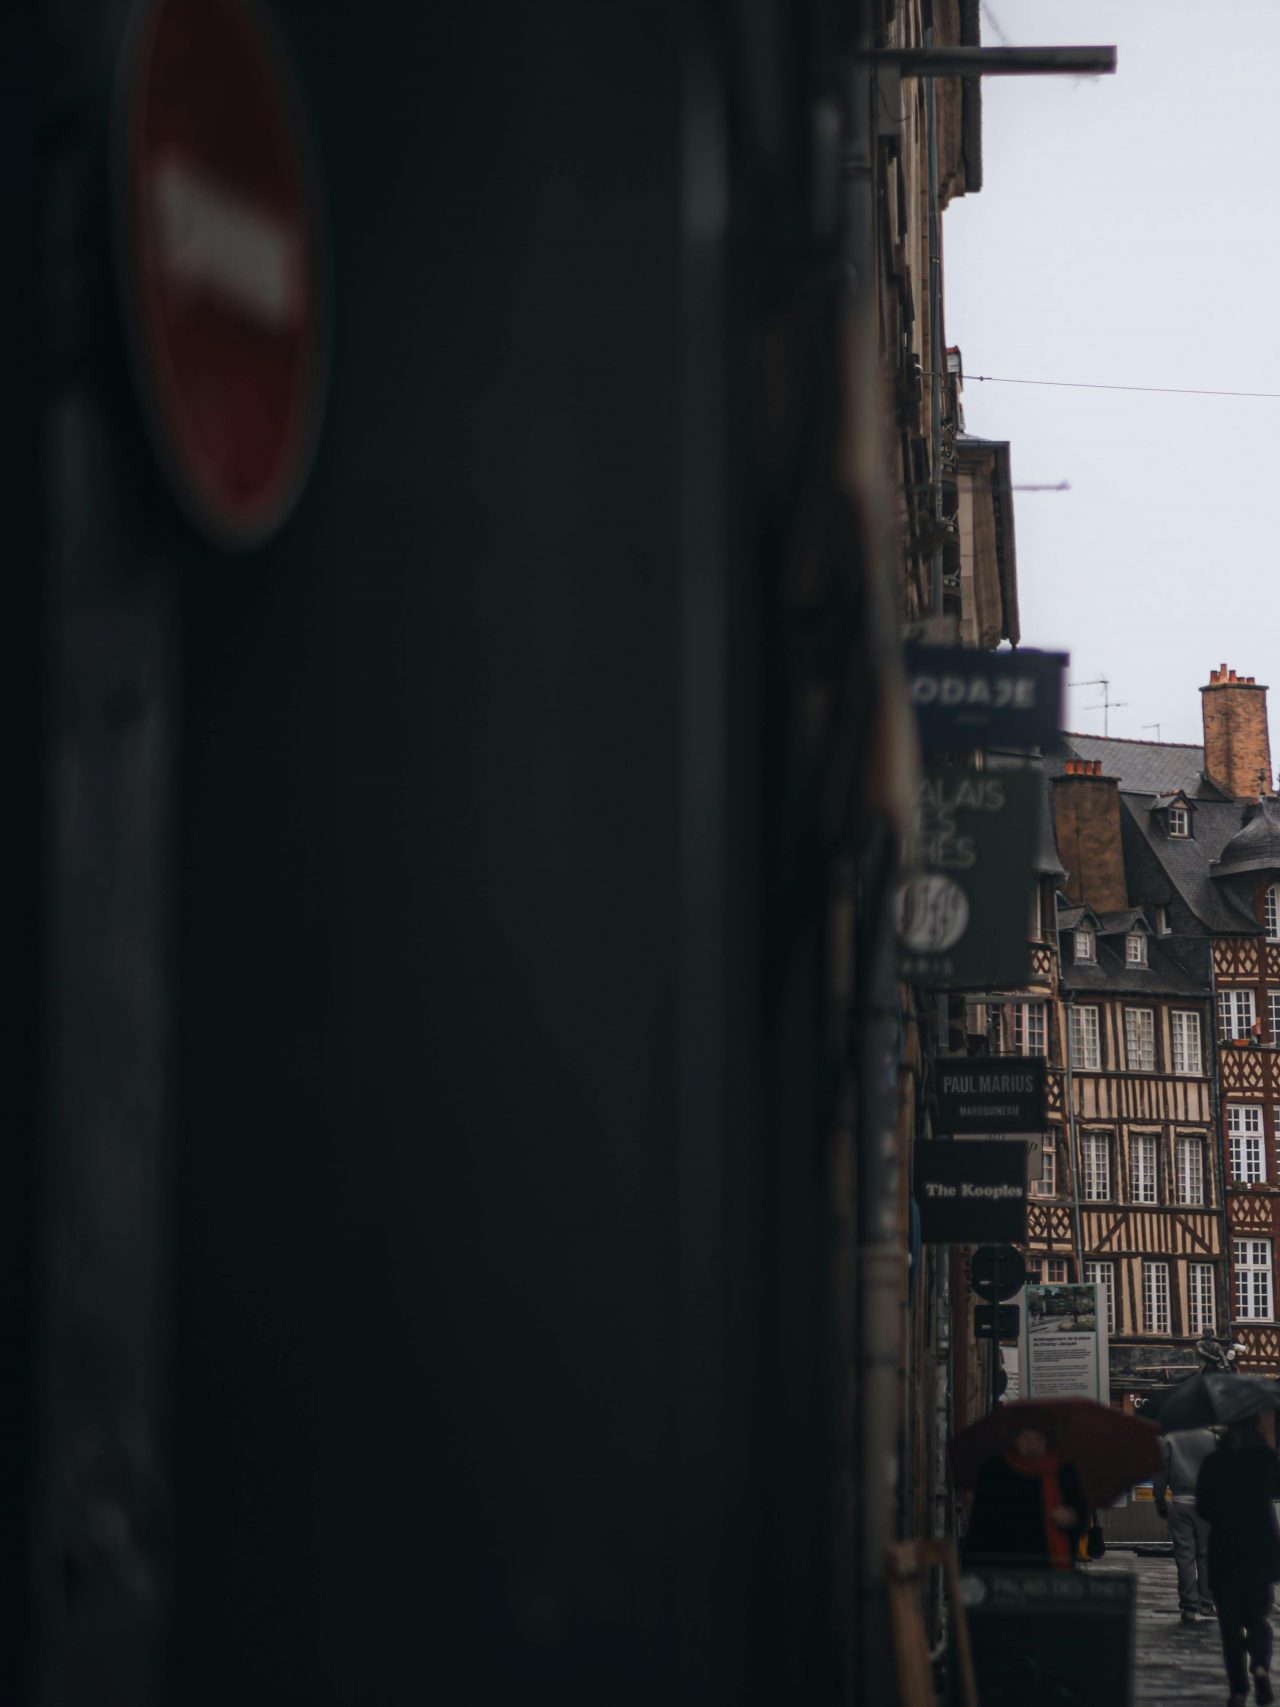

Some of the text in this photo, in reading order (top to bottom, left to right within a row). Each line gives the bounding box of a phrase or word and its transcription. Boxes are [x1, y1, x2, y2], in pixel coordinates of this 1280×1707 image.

[918, 778, 1006, 812] ALAIS
[943, 1074, 1034, 1094] PAUL MARIUS
[959, 1104, 1020, 1117] MAROQUINERIE
[925, 1183, 1024, 1199] The Kooples
